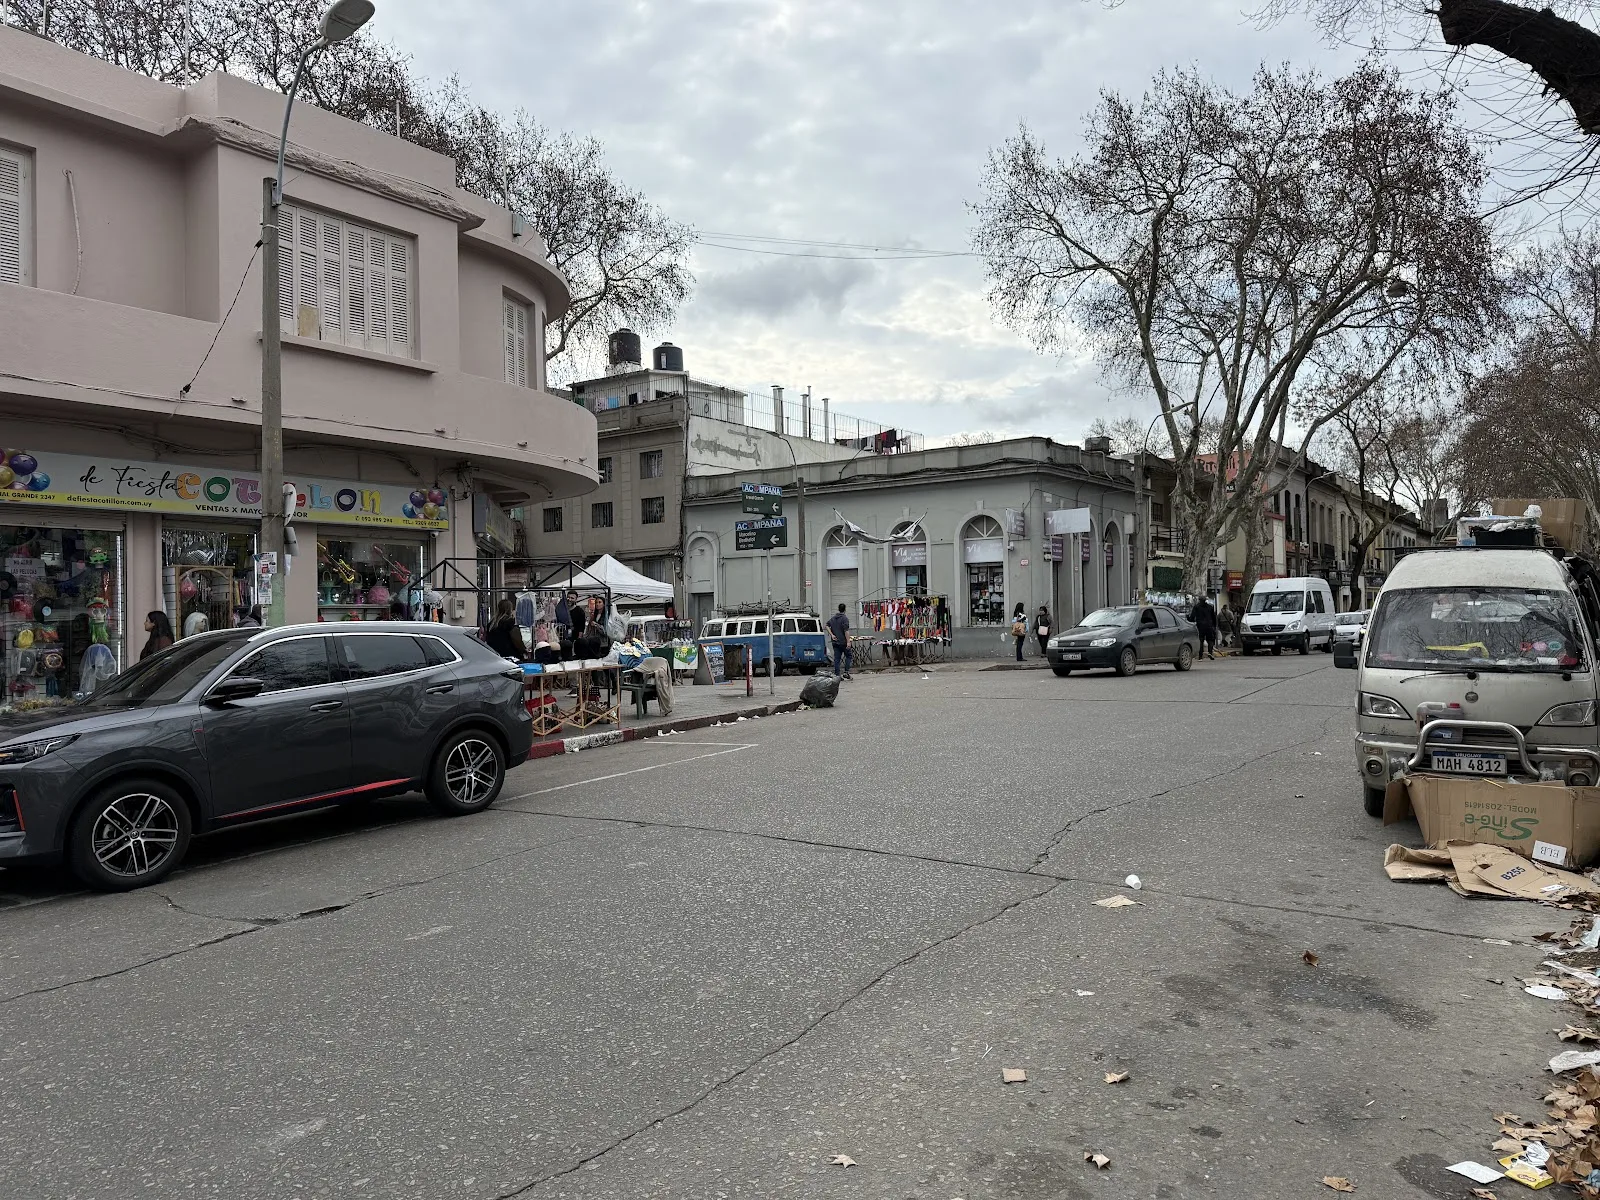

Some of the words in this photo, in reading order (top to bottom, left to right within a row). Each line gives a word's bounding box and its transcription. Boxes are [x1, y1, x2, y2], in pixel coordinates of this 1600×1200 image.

[195, 504, 230, 513] VENTAS
[1436, 758, 1462, 771] MAH
[1468, 759, 1502, 773] 4812
[1500, 866, 1526, 881] B255
